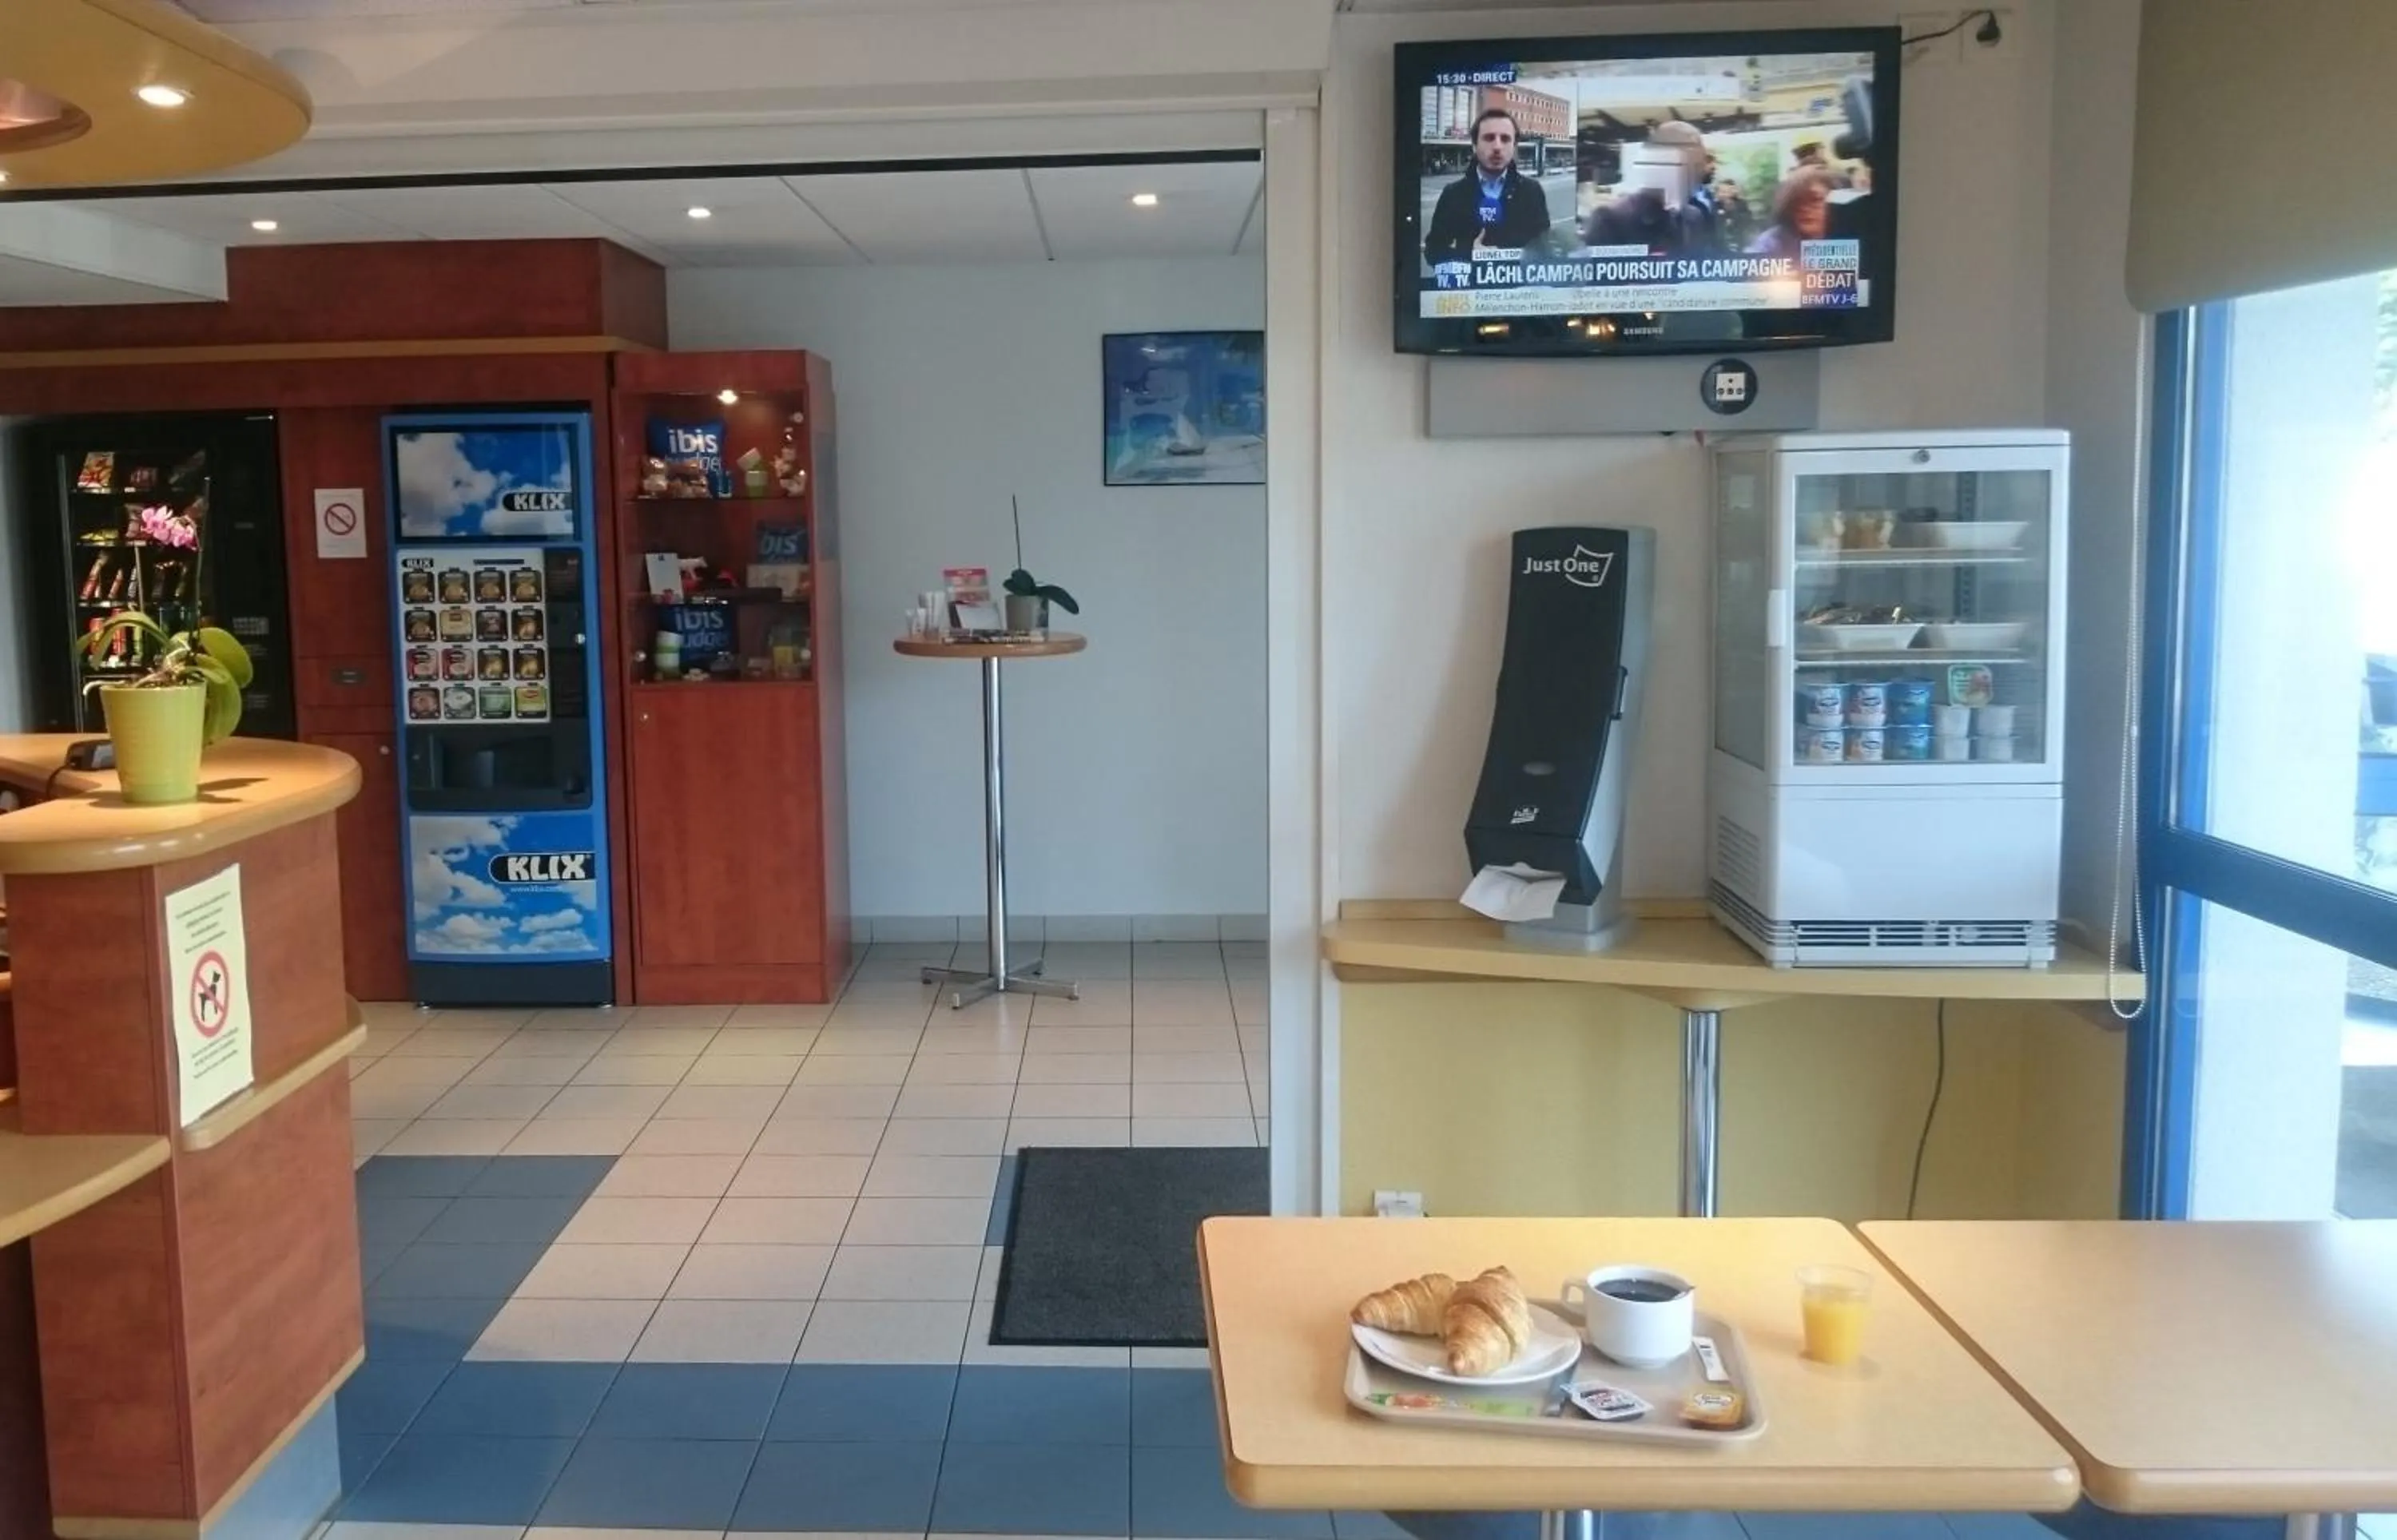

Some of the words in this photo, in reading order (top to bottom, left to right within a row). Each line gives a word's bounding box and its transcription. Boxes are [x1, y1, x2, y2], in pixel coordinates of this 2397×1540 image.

[1473, 71, 1515, 82] DIRECT
[1596, 260, 1676, 280] POURSUIT
[1678, 260, 1698, 279] SA
[1700, 257, 1792, 278] CAMPAGNE
[1818, 256, 1857, 269] GRAND
[1806, 271, 1854, 288] DÉBAT
[1802, 293, 1839, 304] BFMTV
[668, 427, 719, 454] ibis
[513, 492, 566, 511] KLIX
[1522, 557, 1561, 574] Just
[1563, 557, 1600, 573] One
[507, 853, 586, 881] KLIX
